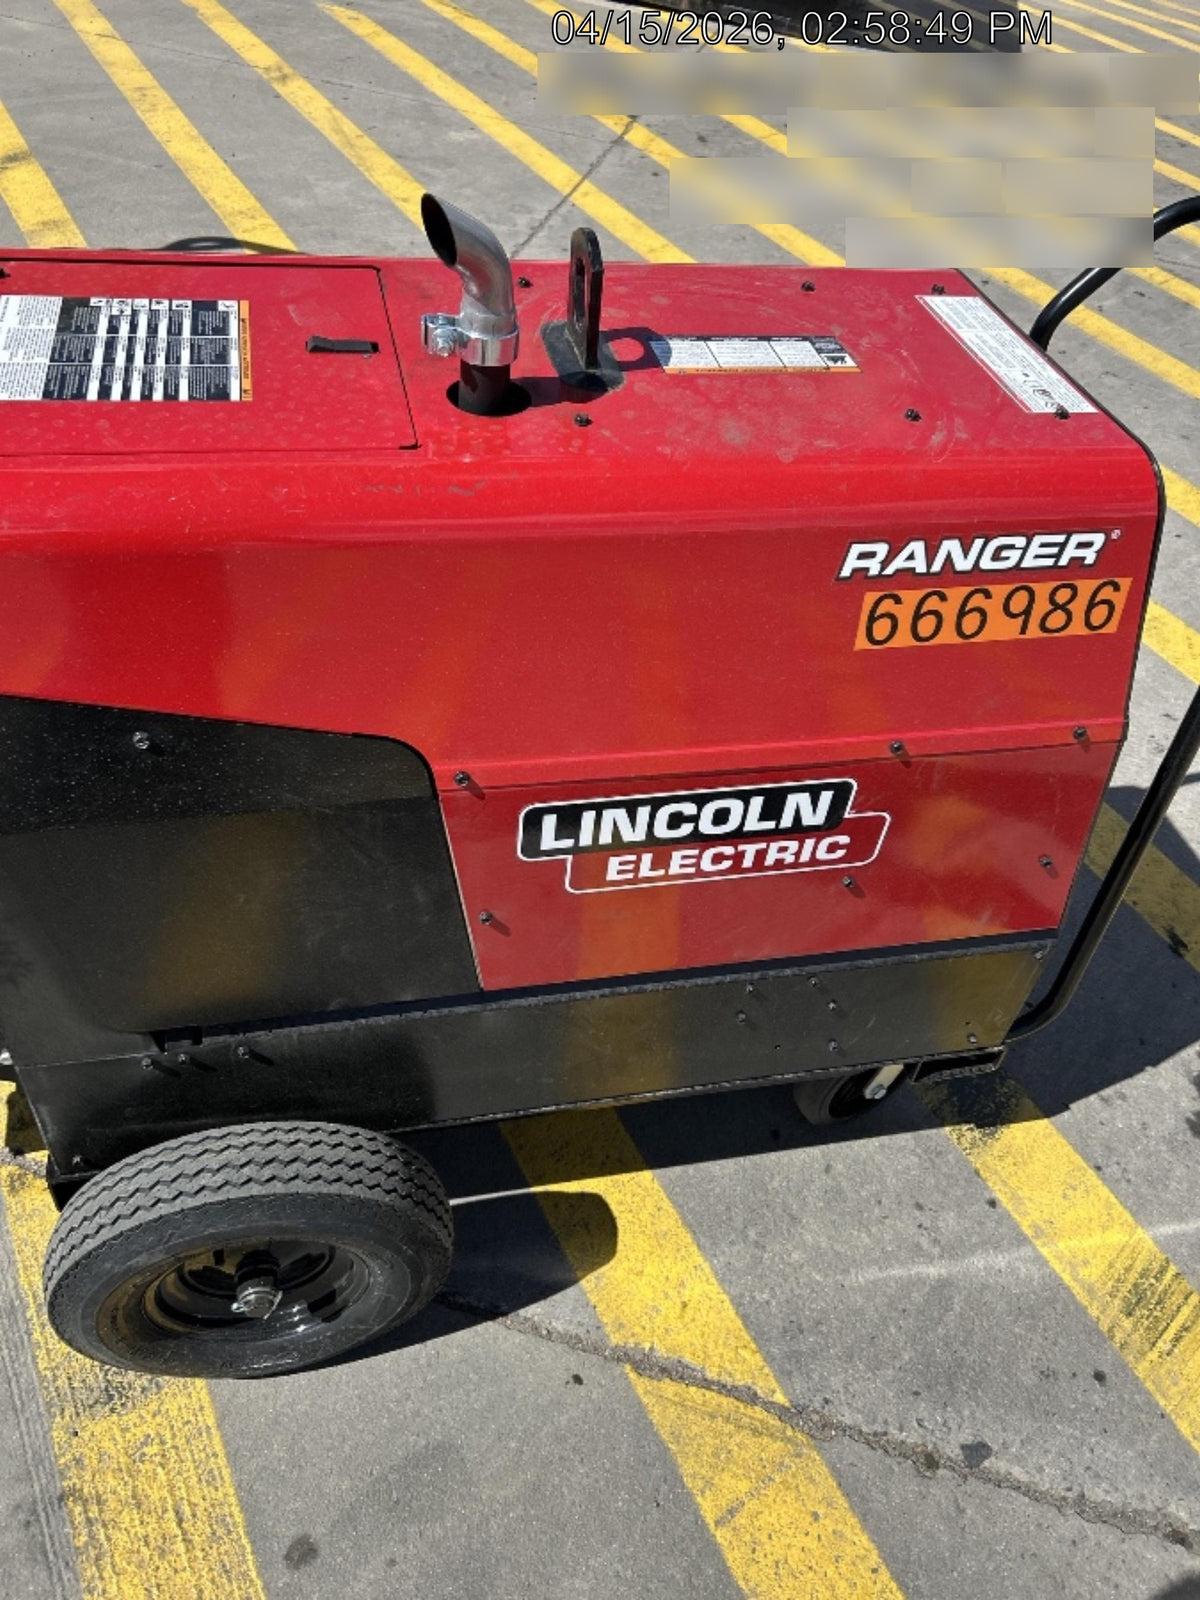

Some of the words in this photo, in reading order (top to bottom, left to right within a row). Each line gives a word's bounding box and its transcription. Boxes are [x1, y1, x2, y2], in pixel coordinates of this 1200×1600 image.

[865, 578, 1121, 646] 666986
[540, 789, 835, 851] LINCOLN
[605, 834, 851, 882] ELECTRIC
